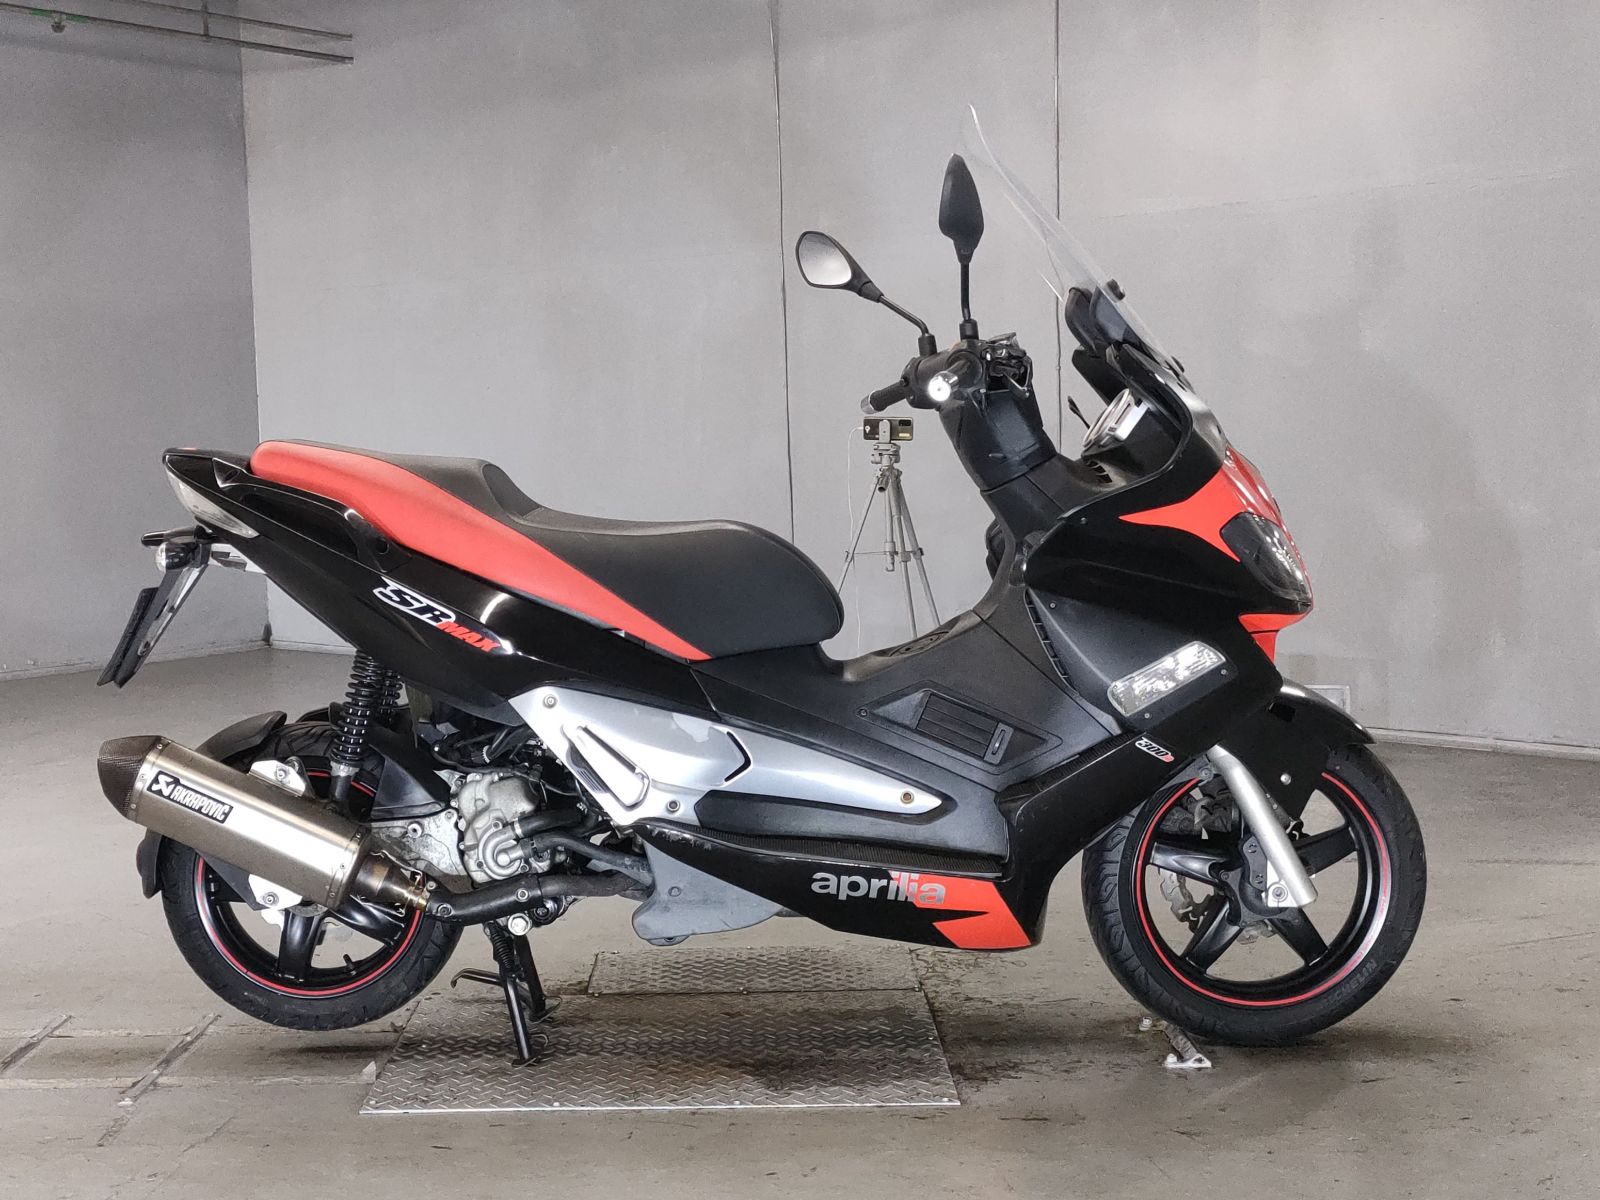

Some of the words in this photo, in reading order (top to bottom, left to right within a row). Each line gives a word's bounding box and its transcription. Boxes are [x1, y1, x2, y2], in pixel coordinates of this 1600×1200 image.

[373, 576, 456, 626] SR
[435, 621, 500, 652] MAX
[811, 871, 946, 904] aprilia
